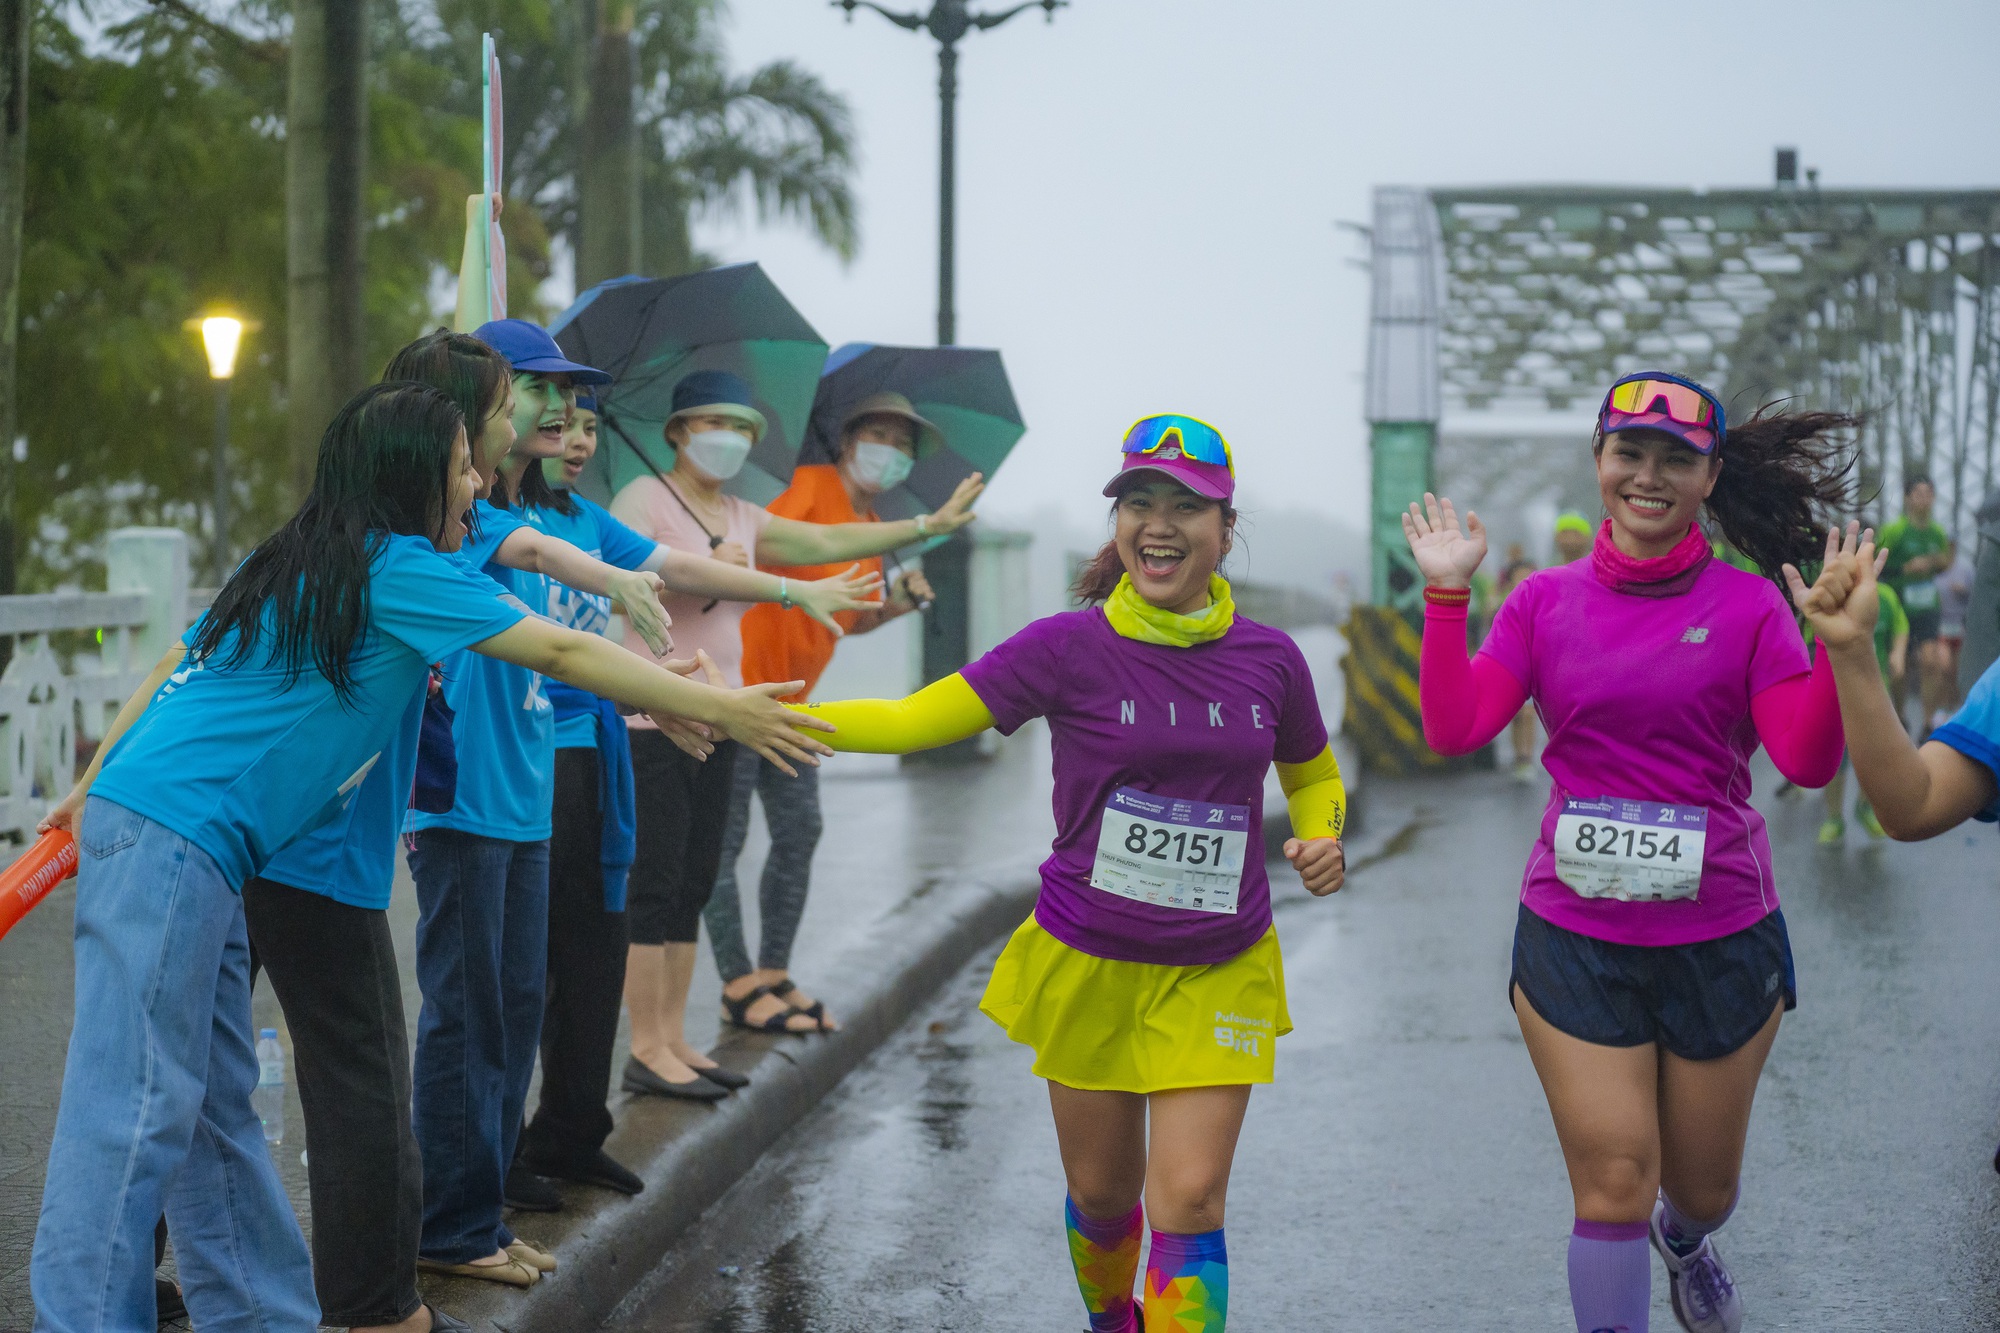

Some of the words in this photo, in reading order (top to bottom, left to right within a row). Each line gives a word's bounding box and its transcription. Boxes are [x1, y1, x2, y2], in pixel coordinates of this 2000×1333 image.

[1121, 699, 1264, 729] NIKE
[1206, 808, 1224, 823] 21
[1230, 814, 1244, 822] 82151
[1657, 808, 1675, 823] 21
[1683, 814, 1700, 822] 82154
[1124, 823, 1224, 867] 82151
[1575, 823, 1682, 862] 82154
[17, 856, 61, 908] MARATHON
